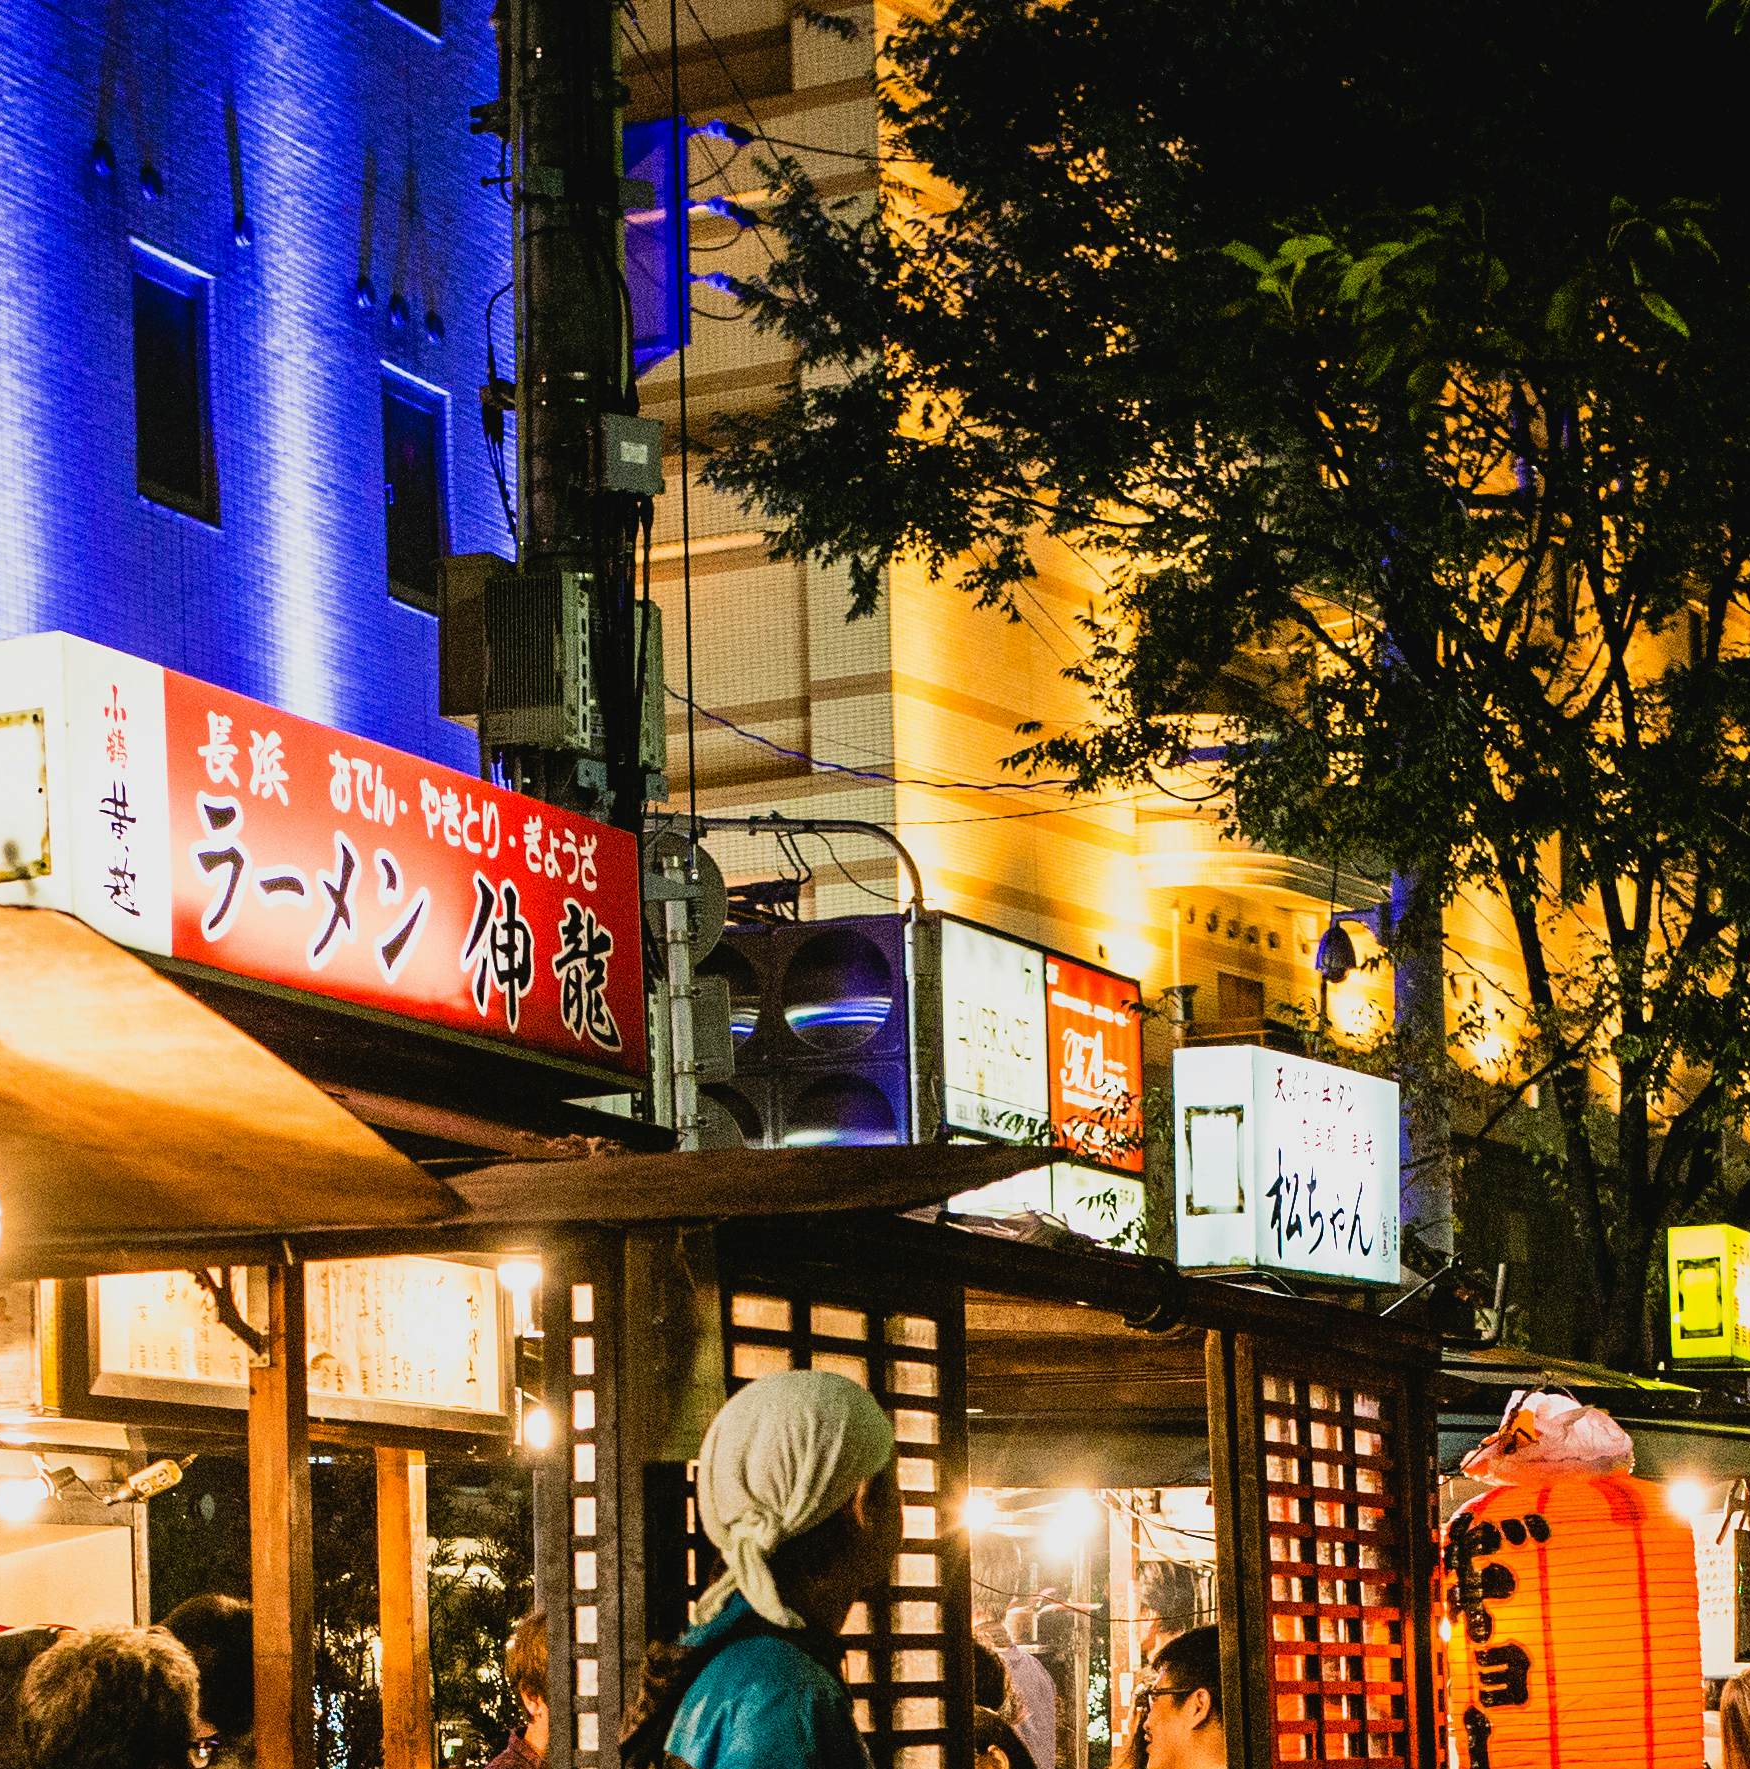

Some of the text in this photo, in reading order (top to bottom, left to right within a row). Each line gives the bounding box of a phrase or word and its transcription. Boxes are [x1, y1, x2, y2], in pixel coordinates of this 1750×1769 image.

[197, 710, 289, 805] 長浜
[190, 791, 622, 1053] ラーメン 伸龍
[1265, 1147, 1374, 1260] 松ちゃん
